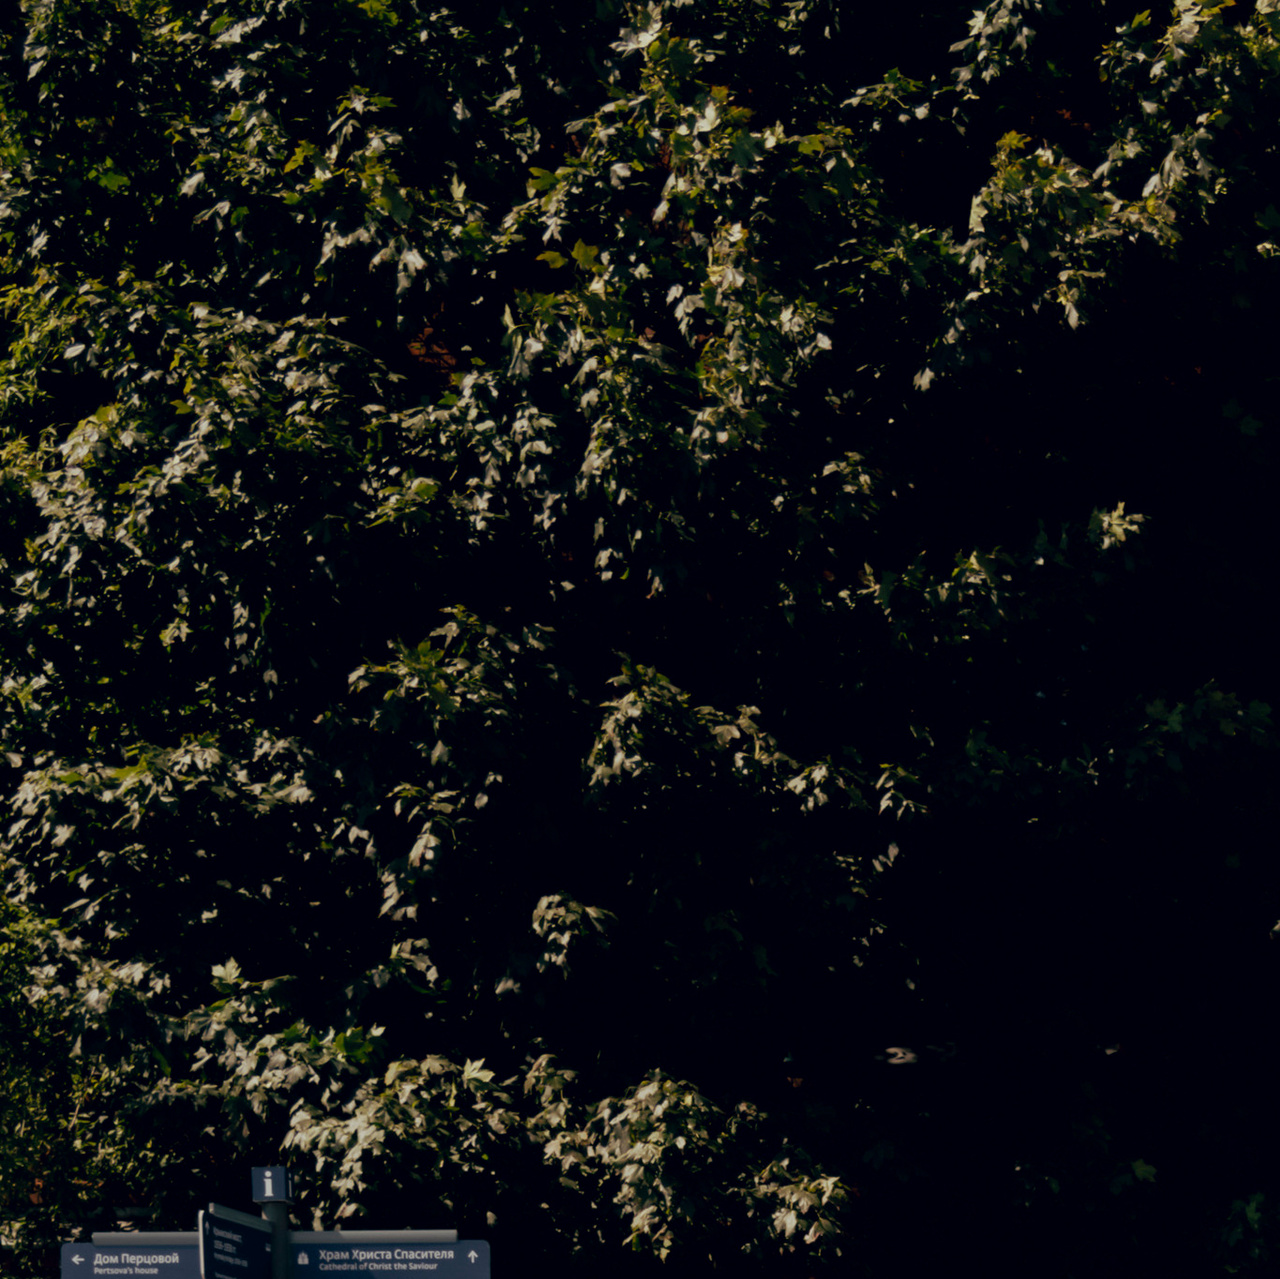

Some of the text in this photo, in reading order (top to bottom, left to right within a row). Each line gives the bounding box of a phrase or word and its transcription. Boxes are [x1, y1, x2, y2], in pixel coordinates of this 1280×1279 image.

[94, 1252, 179, 1266] Дом Перцовой
[319, 1249, 454, 1262] Храм Христа Спасителя
[94, 1267, 159, 1275] Pertsova's house
[319, 1262, 438, 1271] Cathedral of Christ the Saviour
